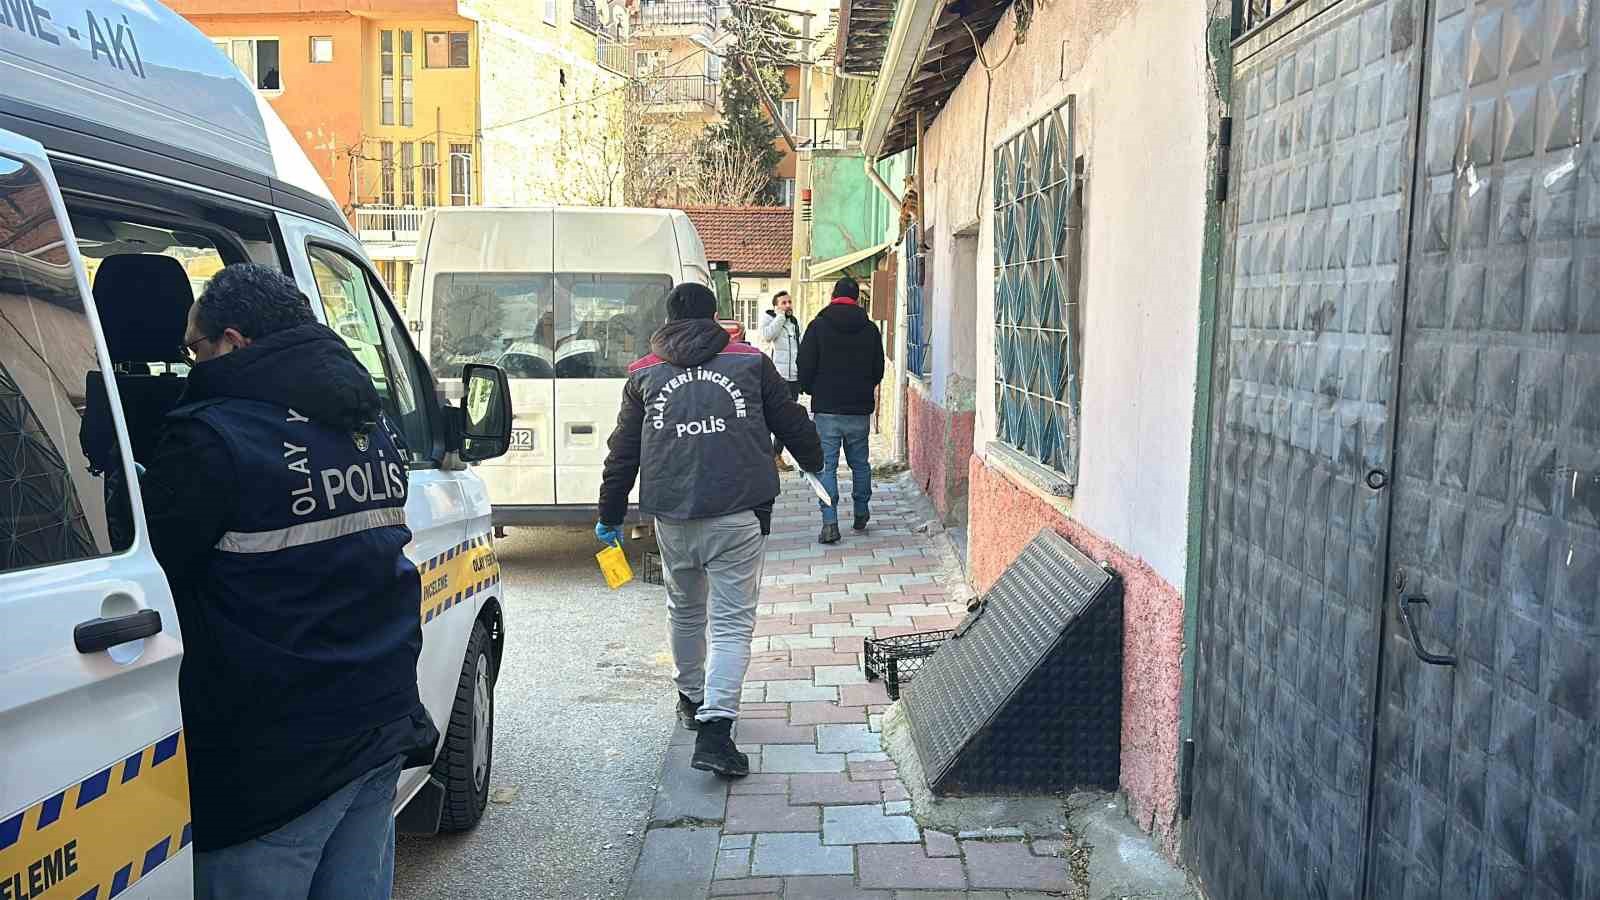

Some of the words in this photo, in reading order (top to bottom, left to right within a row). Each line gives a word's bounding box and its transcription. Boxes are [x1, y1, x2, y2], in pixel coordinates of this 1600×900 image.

[0, 0, 60, 45] ME
[86, 10, 145, 79] AKİ
[653, 392, 667, 429] OLAY
[662, 368, 693, 394] YERİ
[697, 366, 746, 418] İNCELEME
[676, 416, 726, 437] POLİS
[284, 442, 316, 515] OLAY
[320, 449, 405, 510] POLİS
